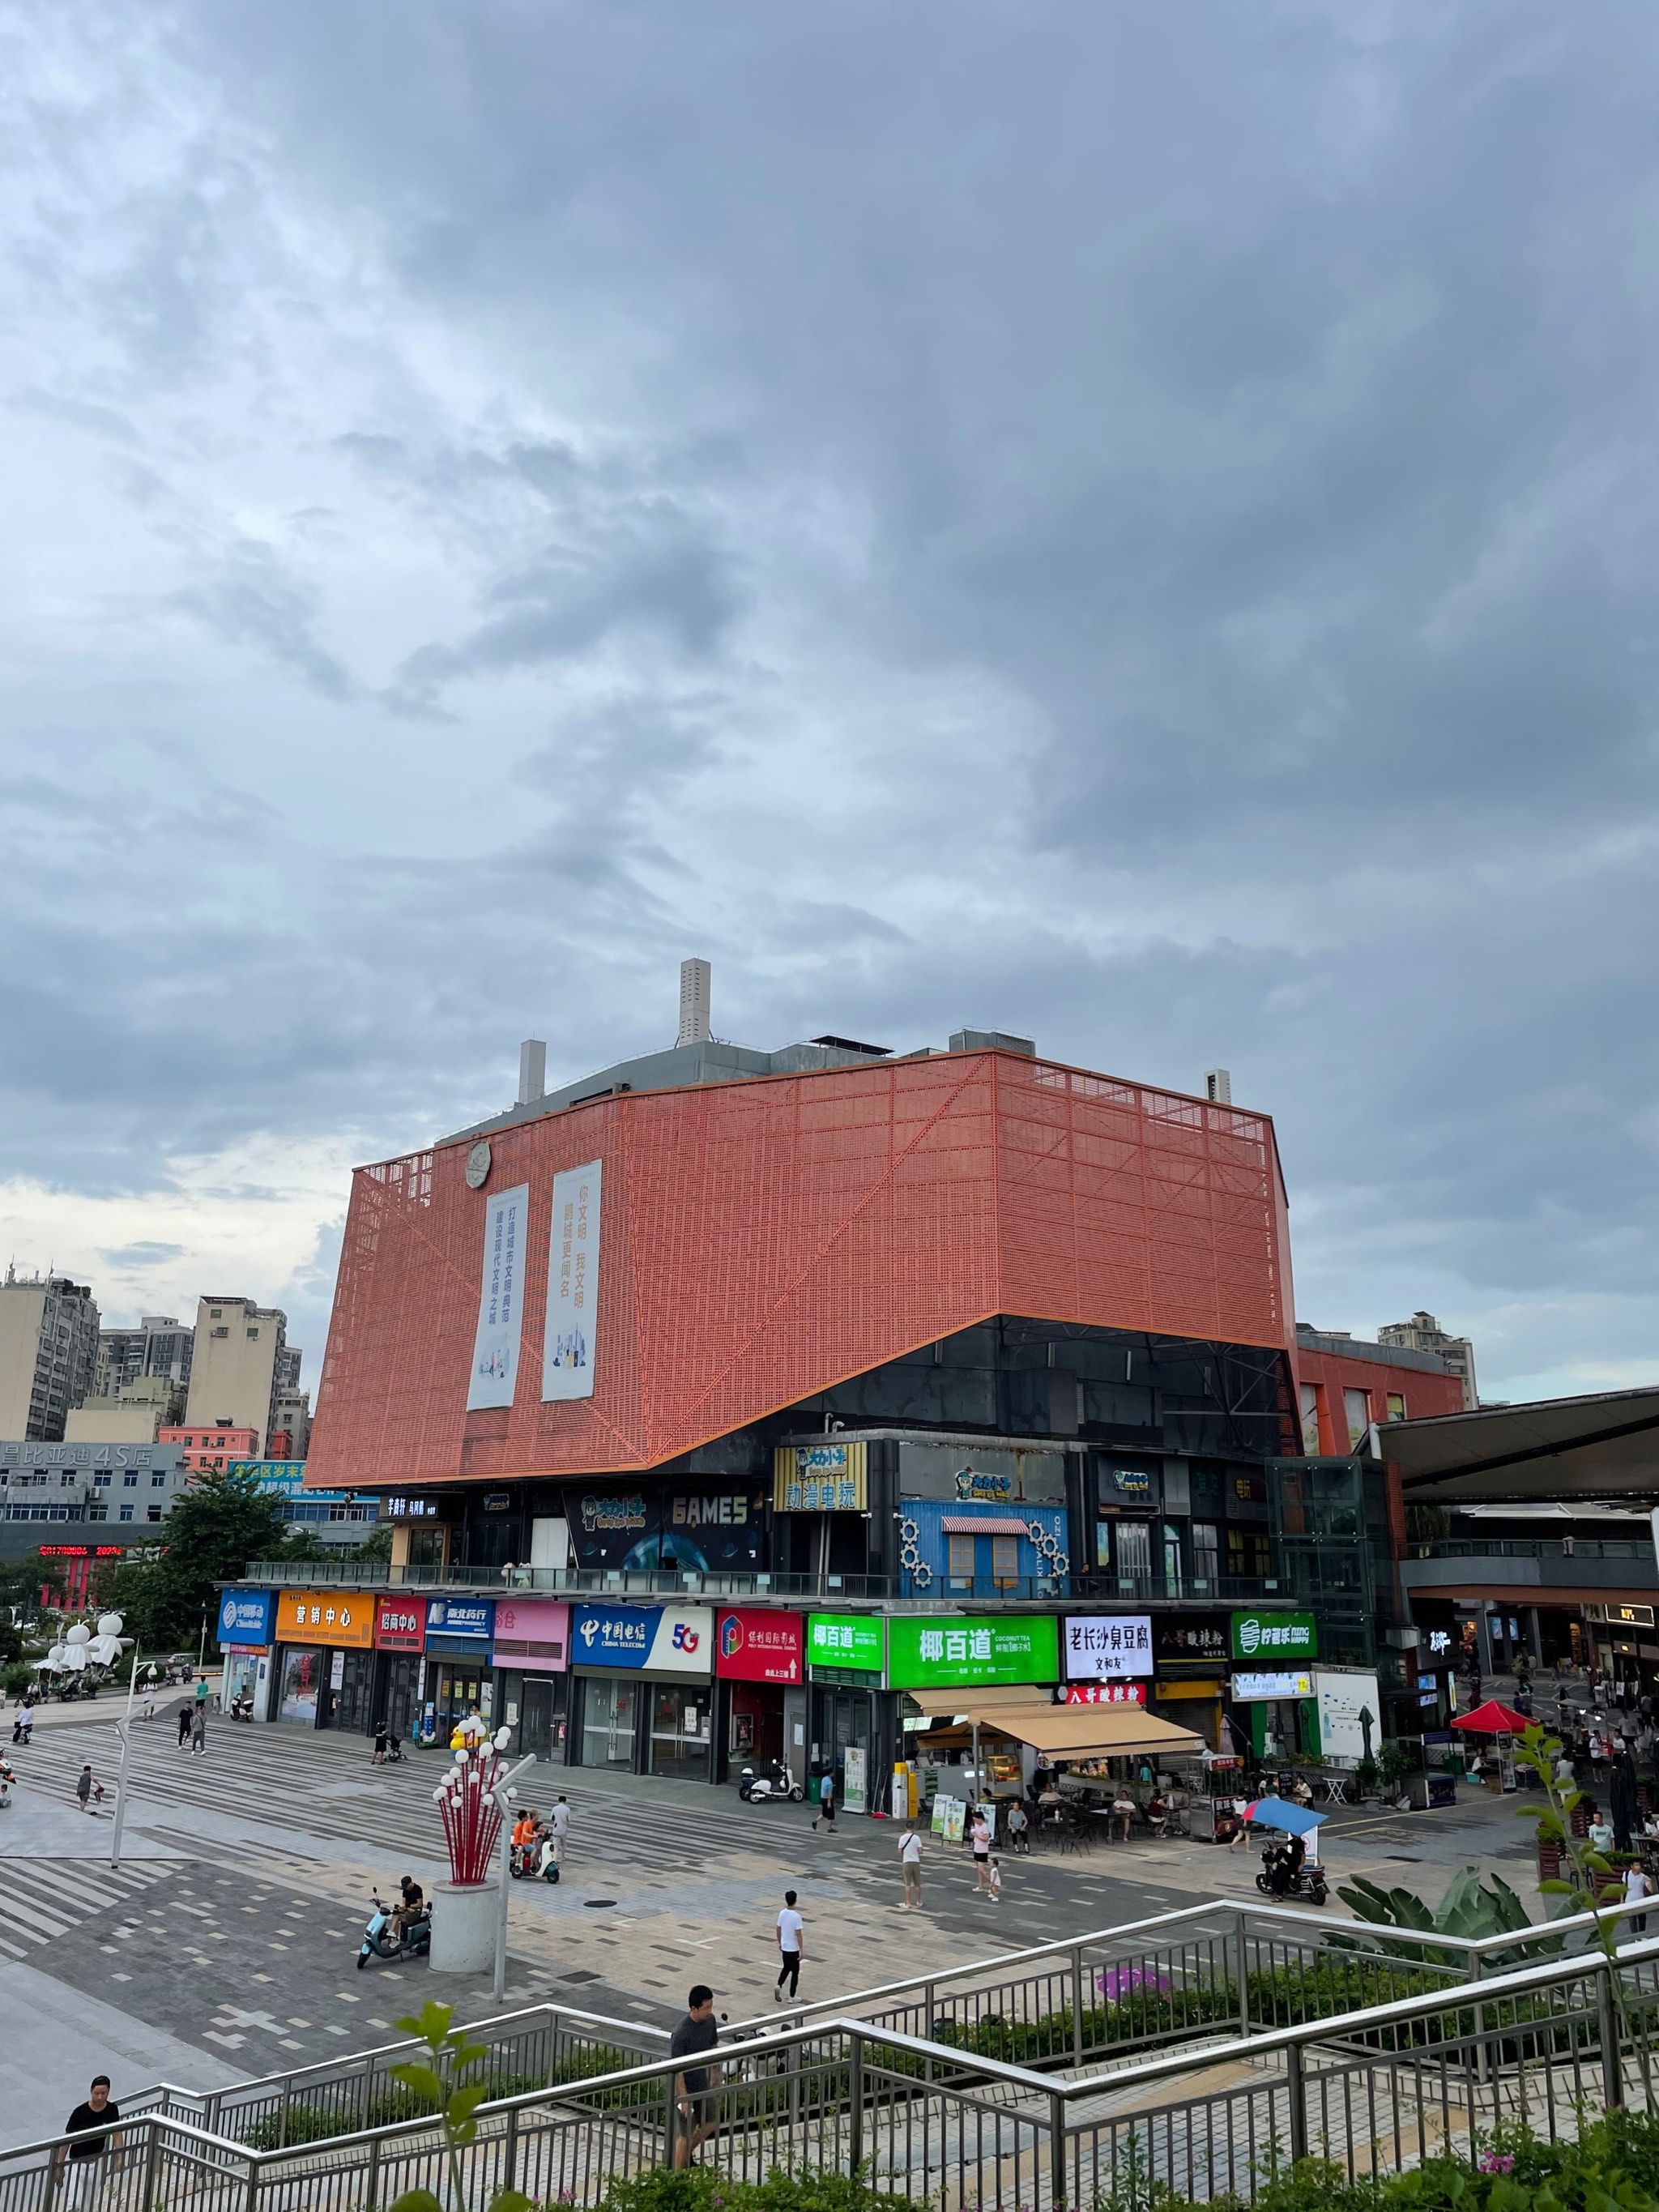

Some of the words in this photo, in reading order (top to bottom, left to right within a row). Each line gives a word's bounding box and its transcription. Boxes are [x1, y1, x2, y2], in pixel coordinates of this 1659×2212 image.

[578, 1185, 588, 1240] 你文明
[561, 1202, 573, 1298] 鹏城更闻名
[488, 1211, 503, 1325] 建设现代文明之城
[502, 1206, 516, 1323] 打造城市文明典范
[574, 1253, 585, 1309] 我文明
[973, 1475, 1011, 1491] 大力小子
[598, 1497, 646, 1517] 大力小子
[787, 1482, 855, 1510] 动漫电玩
[672, 1497, 747, 1524] GAMES
[237, 1603, 263, 1619] 中国移动
[296, 1605, 351, 1627] 营销中心
[382, 1613, 416, 1632] 招商中心
[447, 1608, 486, 1621] 南北药行
[602, 1620, 646, 1641] 中国电信
[672, 1624, 700, 1654] 5G
[748, 1631, 797, 1646] 保利国际影城
[813, 1624, 853, 1648] 椰百道
[1070, 1625, 1149, 1650] 老长沙臭豆腐
[1162, 1629, 1224, 1648] 八哥酸辣粉
[920, 1629, 992, 1662] 椰百道
[1095, 1657, 1122, 1671] 文和友
[1070, 1686, 1139, 1704] 八哥酸辣粉
